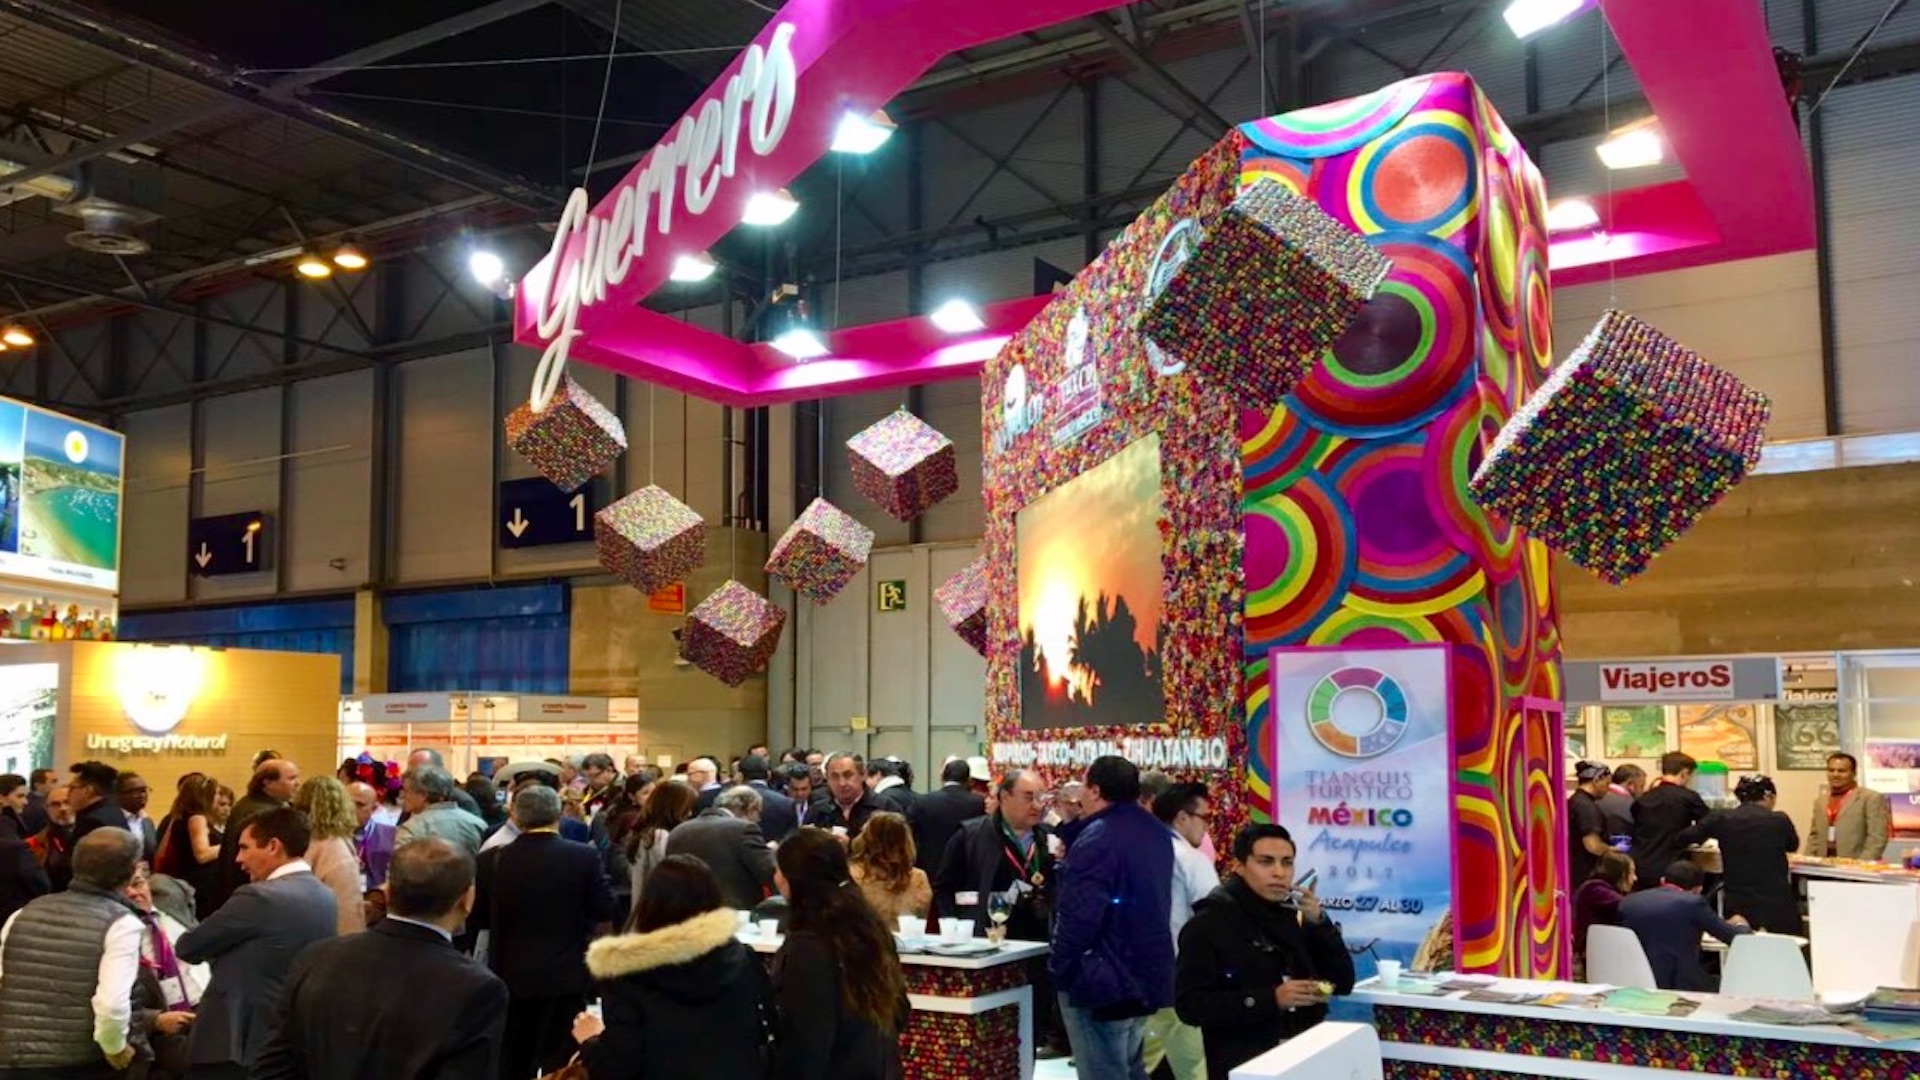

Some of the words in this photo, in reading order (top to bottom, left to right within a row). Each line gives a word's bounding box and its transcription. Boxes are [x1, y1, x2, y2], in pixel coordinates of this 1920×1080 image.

[530, 21, 797, 413] Guerrero
[569, 493, 586, 531] 1
[1602, 664, 1731, 694] ViajeroS
[1305, 770, 1412, 786] TIANGUIS
[1308, 828, 1414, 862] Acapulco
